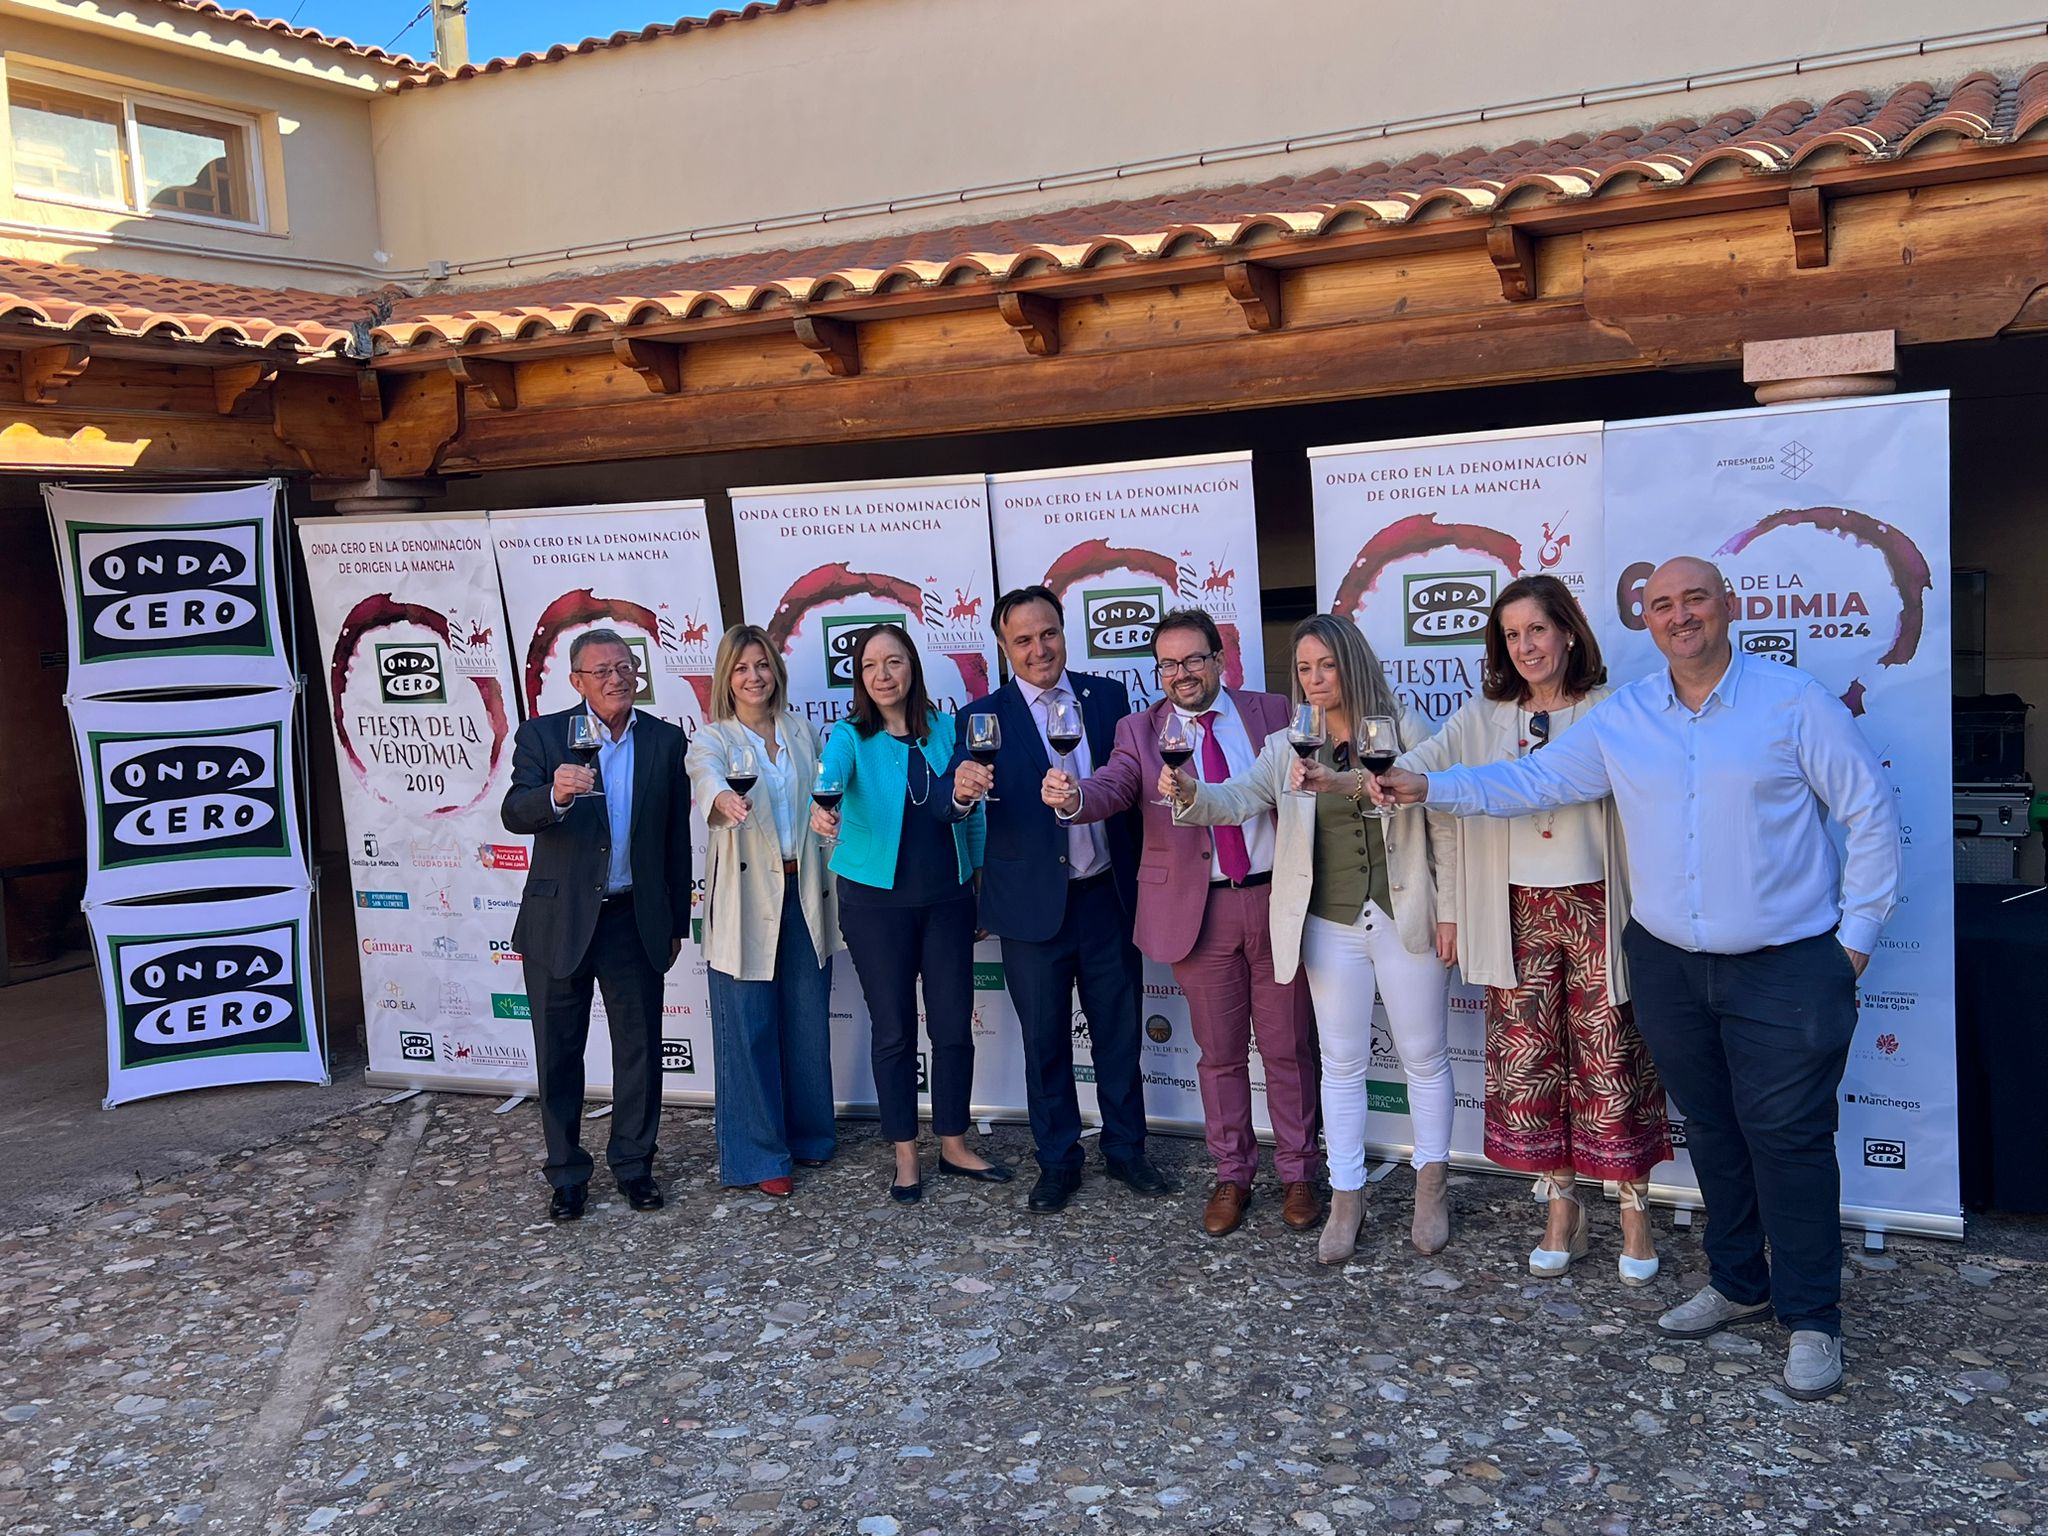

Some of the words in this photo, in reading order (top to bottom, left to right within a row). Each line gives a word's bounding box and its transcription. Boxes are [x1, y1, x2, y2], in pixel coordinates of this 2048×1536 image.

[1326, 473, 1366, 486] ONDA
[1371, 468, 1408, 482] CERO
[1414, 466, 1432, 478] EN
[1438, 464, 1454, 476] LA
[1460, 451, 1587, 474] DENOMINACIÓN
[1717, 456, 1774, 467] ATRESMEDIA
[1005, 497, 1042, 509] ONDA
[1047, 493, 1080, 505] CERO
[1086, 491, 1102, 502] EN
[1107, 490, 1123, 501] LA
[1127, 478, 1239, 499] DENOMINACIÓN
[1367, 490, 1385, 501] DE
[1390, 485, 1446, 500] ORIGEN
[1452, 484, 1469, 495] LA
[1474, 479, 1541, 493] MANCHA
[739, 509, 778, 521] ONDA
[783, 507, 818, 519] CERO
[824, 506, 840, 516] EN
[846, 505, 862, 515] LA
[867, 496, 981, 514] DENOMINACIÓN
[1044, 513, 1061, 524] DE
[1065, 510, 1115, 523] ORIGEN
[1121, 508, 1137, 518] LA
[1141, 503, 1200, 517] MANCHA
[780, 527, 797, 537] DE
[802, 524, 855, 536] ORIGEN
[860, 523, 876, 533] LA
[880, 520, 941, 532] MANCHA
[311, 543, 338, 555] ONDA
[340, 542, 366, 554] CERO
[370, 541, 383, 553] EN
[385, 541, 399, 553] LA
[402, 536, 481, 552] DENOMINACIÓN
[500, 538, 530, 549] ONDA
[533, 536, 564, 548] CERO
[568, 535, 582, 546] EN
[586, 534, 600, 545] LA
[604, 528, 700, 544] DENOMINACIÓN
[533, 555, 548, 565] DE
[551, 552, 595, 564] ORIGEN
[600, 551, 614, 562] LA
[617, 550, 669, 561] MANCHA
[104, 552, 232, 581] ONDA
[339, 562, 352, 574] DE
[354, 561, 392, 573] ORIGEN
[395, 561, 409, 573] LA
[411, 560, 455, 572] MANCHA
[1741, 575, 1769, 590] DE
[1776, 574, 1803, 589] LA
[1419, 589, 1479, 605] ONDA
[116, 600, 236, 630] CERO
[1098, 607, 1149, 621] ONDA
[1423, 614, 1479, 630] CERO
[942, 632, 983, 641] MANCHA
[1103, 630, 1150, 644] CERO
[1809, 623, 1871, 638] 2024
[1748, 639, 1787, 649] ONDA
[388, 657, 430, 669] ONDA
[675, 655, 712, 664] MANCHA
[393, 678, 433, 691] CERO
[358, 715, 427, 741] FIESTA
[426, 716, 454, 737] DE
[459, 715, 482, 743] LA
[369, 738, 473, 770] VENDIMIA
[125, 757, 252, 787] ONDA
[405, 773, 445, 795] 2019
[136, 804, 255, 837] CERO
[497, 853, 524, 861] ALCÁZAR
[362, 938, 413, 955] Cámara
[145, 955, 269, 989] ONDA
[1864, 994, 1915, 1005] Villarrubia
[1891, 1003, 1910, 1011] Ojos
[156, 1001, 274, 1036] CERO
[407, 1047, 429, 1055] CERO
[484, 1046, 527, 1058] MANCHA
[1142, 1074, 1196, 1088] Manchegos
[1858, 1094, 1921, 1109] Manchegos
[1870, 1145, 1898, 1153] ONDA
[1872, 1155, 1898, 1163] CERO
